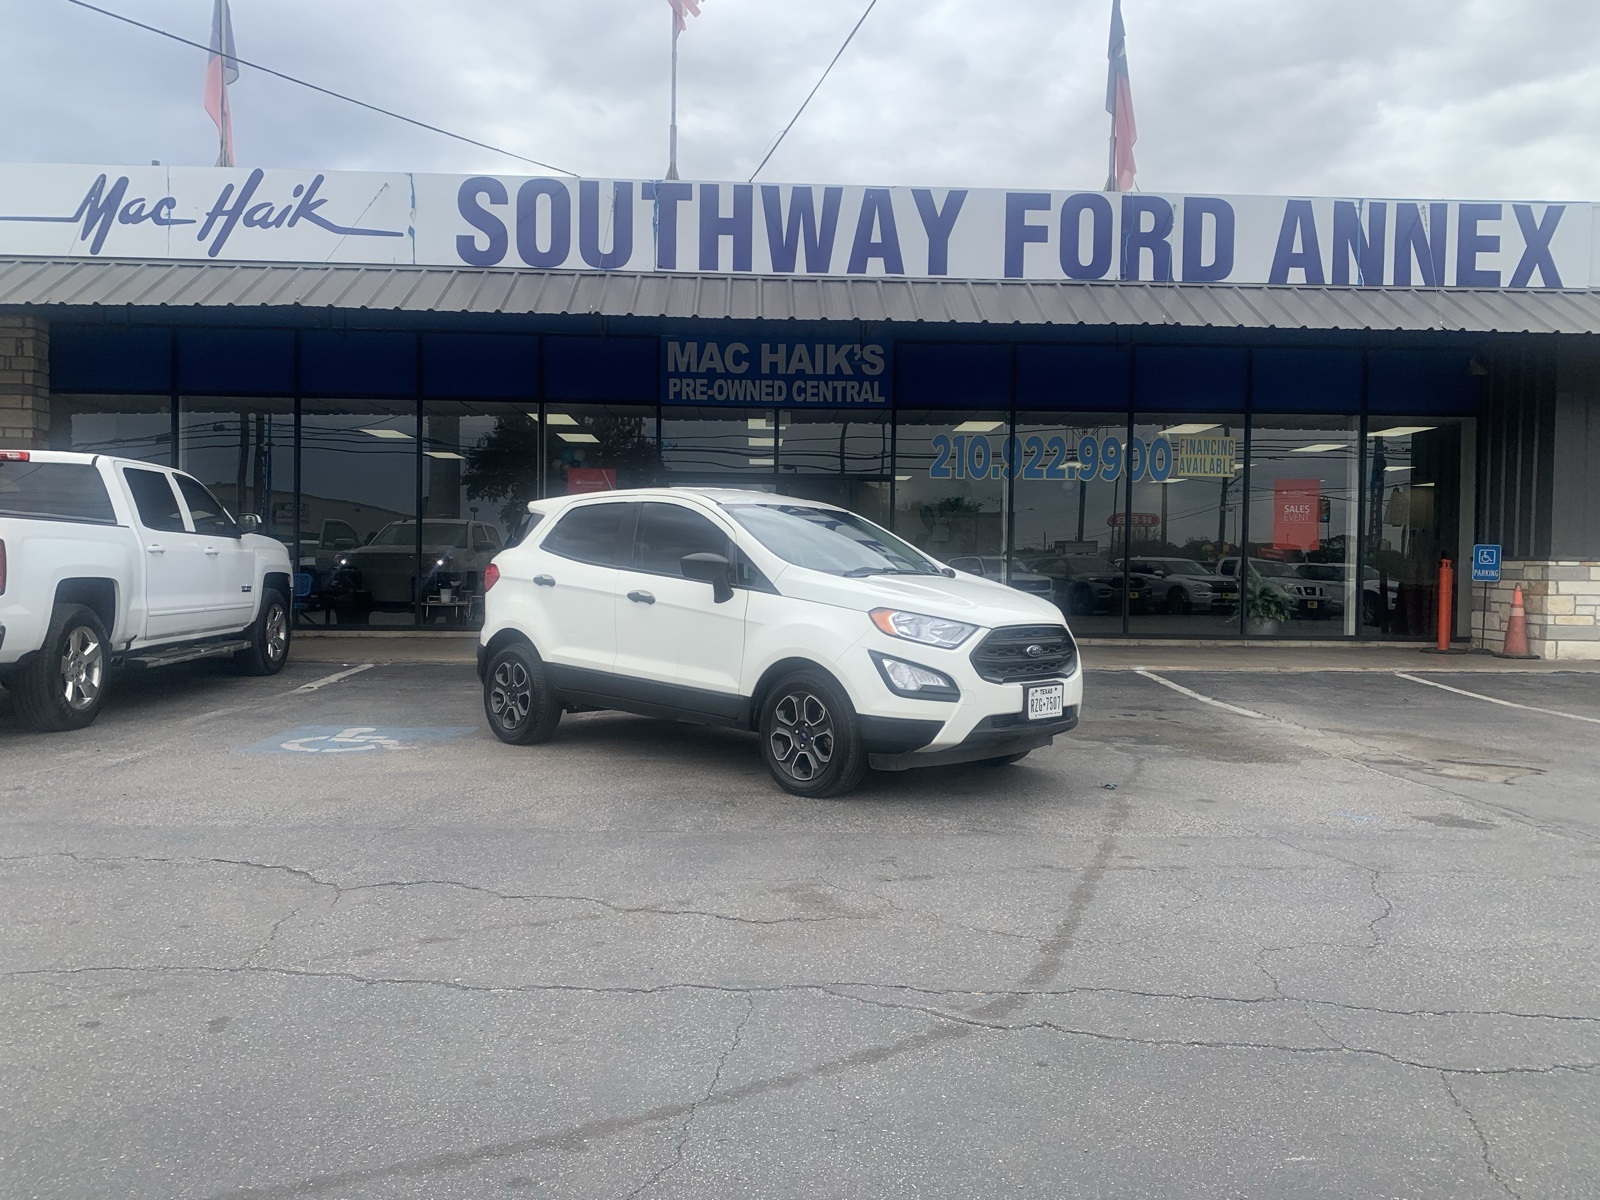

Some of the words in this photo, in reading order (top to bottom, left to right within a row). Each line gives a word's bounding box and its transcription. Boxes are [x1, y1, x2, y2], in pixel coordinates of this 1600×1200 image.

[72, 173, 197, 256] Mac
[196, 167, 404, 258] Haik
[455, 176, 969, 277] SOUTHWAY
[1003, 191, 1236, 282] FORD
[1267, 198, 1567, 290] ANNEX
[667, 341, 750, 374] MAC
[760, 342, 886, 376] HAIK'S
[668, 378, 787, 402] PRE-OWNED
[791, 380, 886, 403] CENTRAL
[1179, 438, 1235, 456] FINANCING
[929, 434, 1174, 482] 210.922.9900
[1179, 457, 1235, 475] AVAILABLE
[1284, 504, 1310, 513] SALES
[1284, 513, 1310, 522] EVENT
[1473, 569, 1499, 577] PARKING
